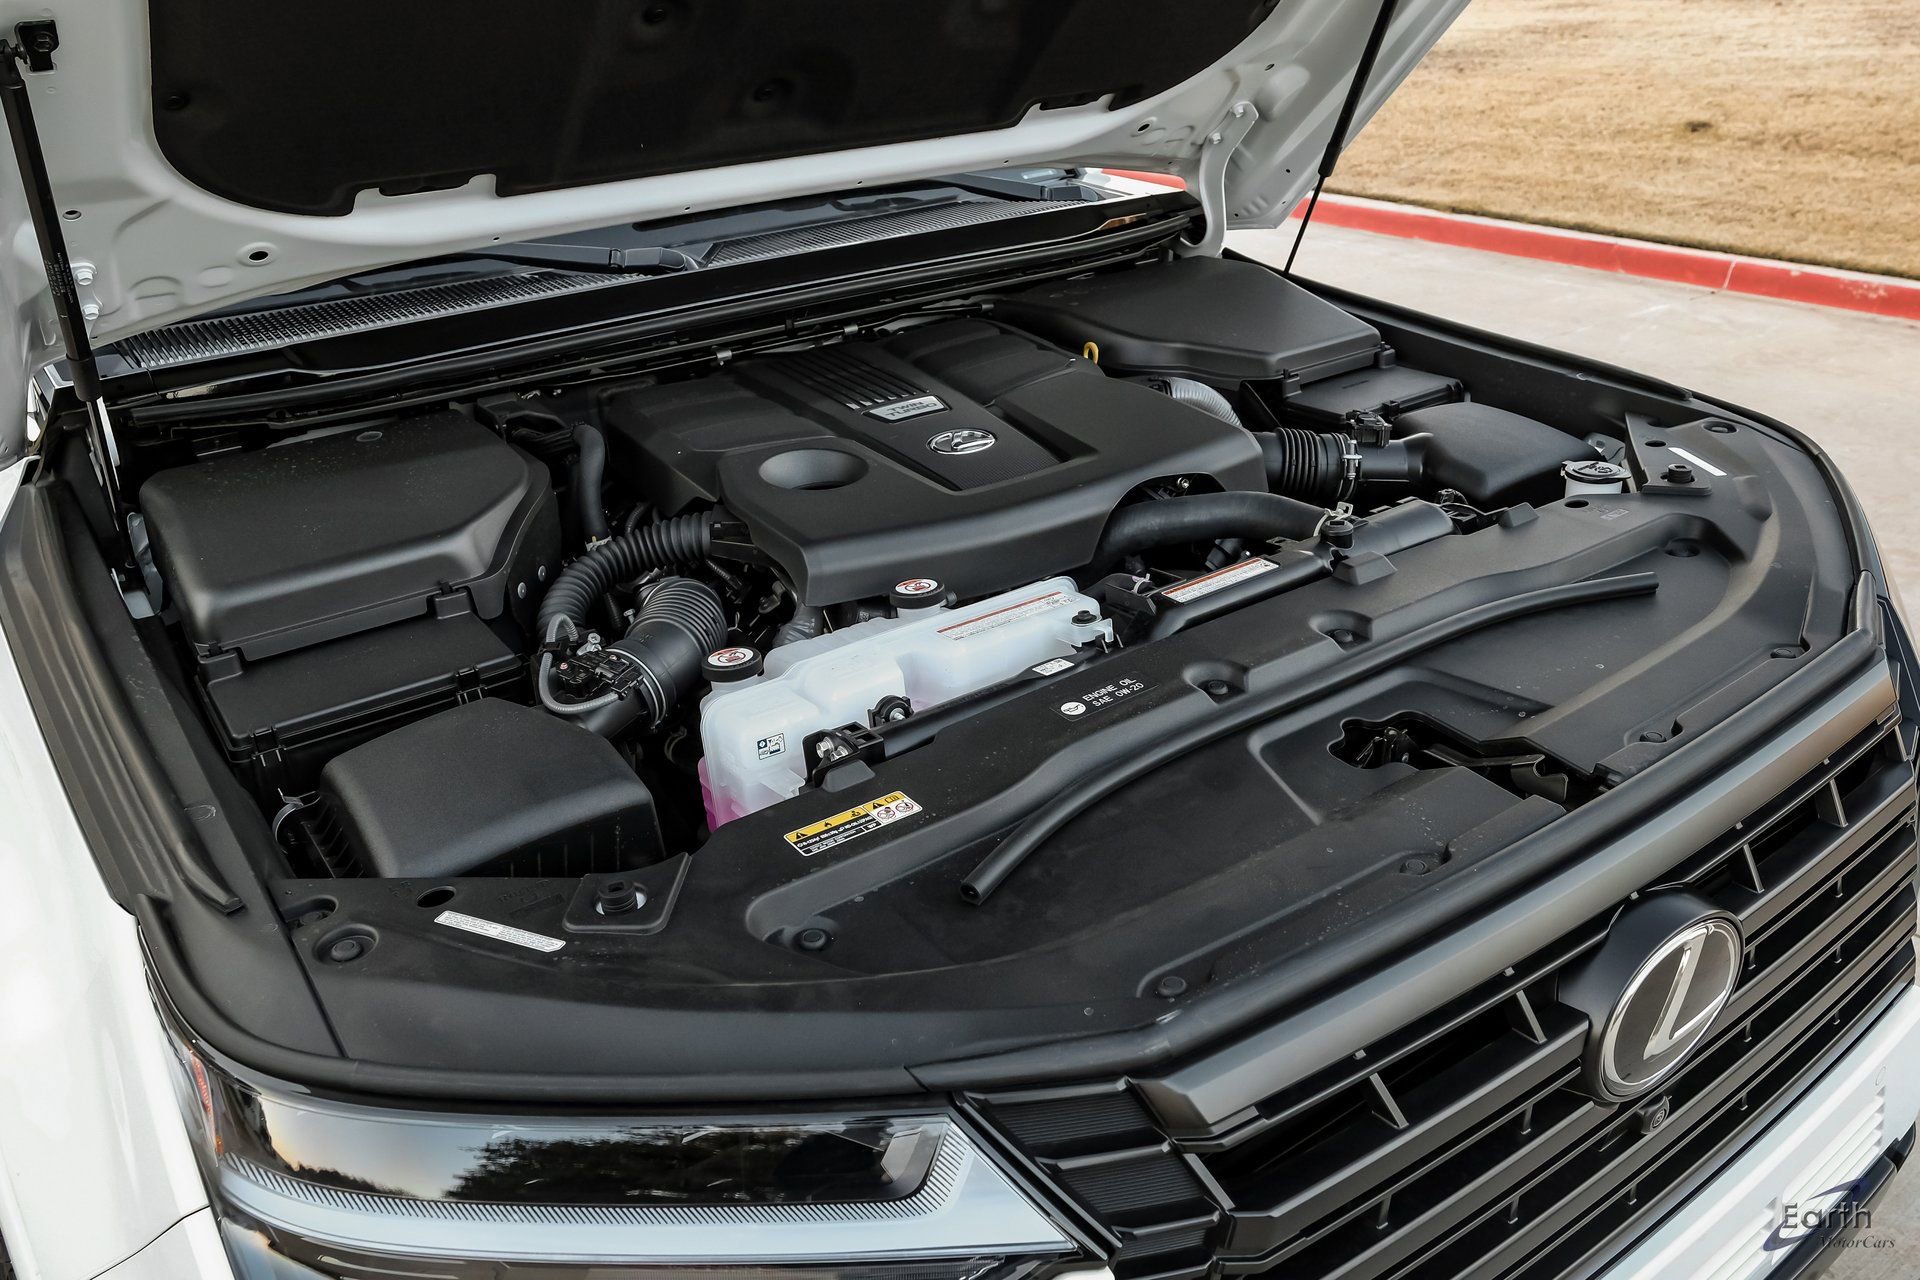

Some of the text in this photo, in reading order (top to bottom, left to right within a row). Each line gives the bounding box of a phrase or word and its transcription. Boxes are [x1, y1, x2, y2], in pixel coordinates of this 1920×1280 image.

[884, 402, 937, 417] TURBO
[886, 401, 924, 411] TWIN
[1082, 678, 1137, 702] ENGINE OIL
[1092, 695, 1114, 707] SAE
